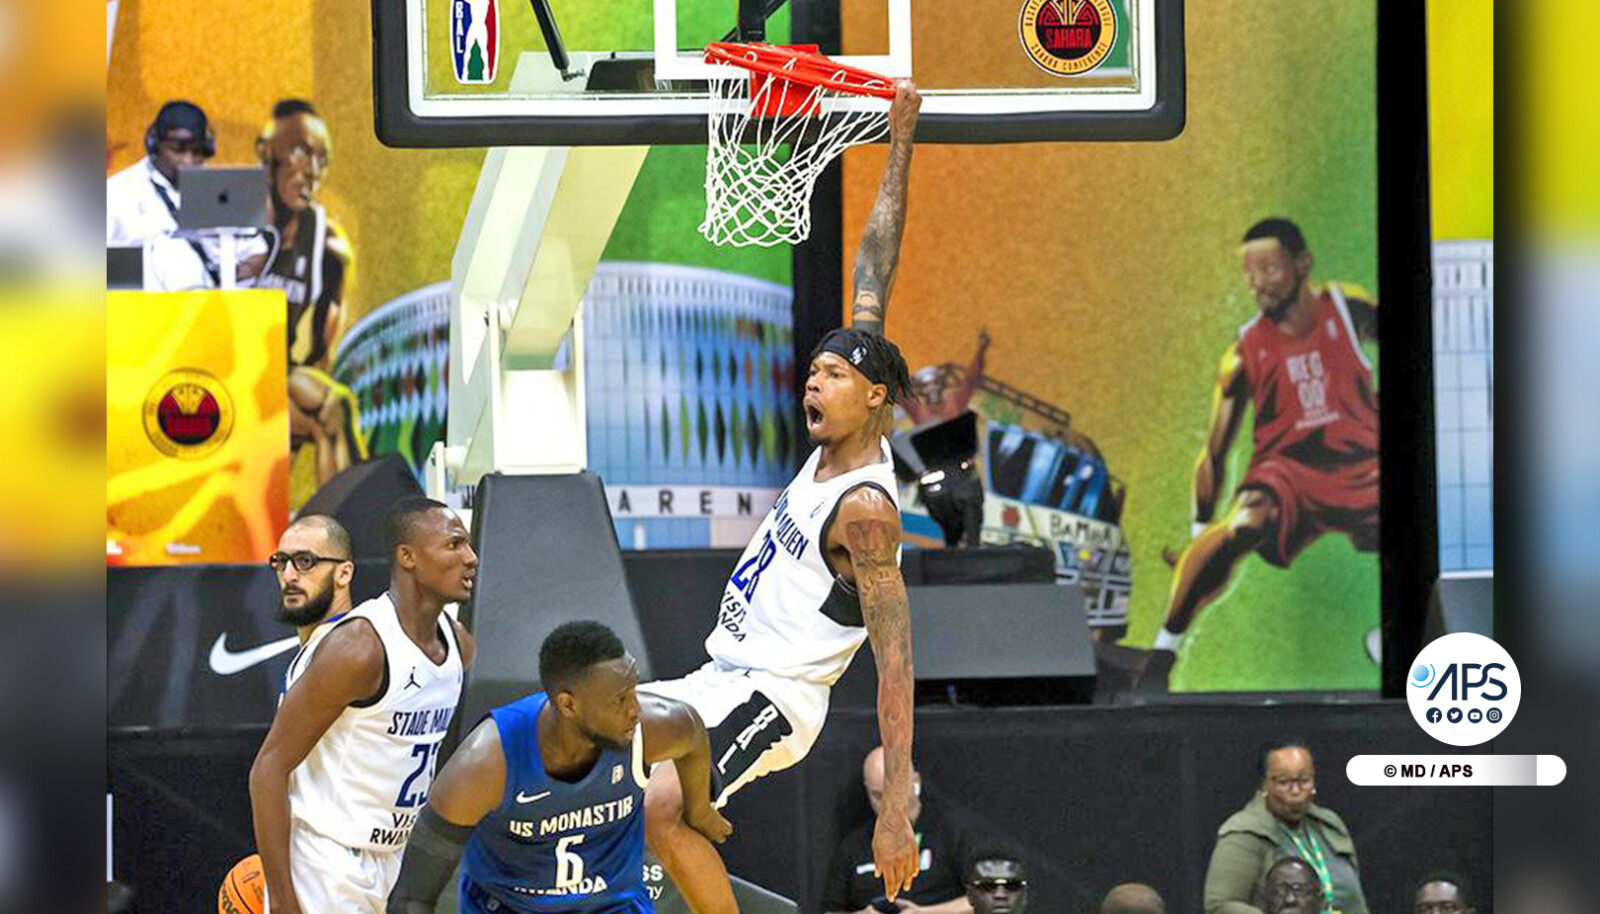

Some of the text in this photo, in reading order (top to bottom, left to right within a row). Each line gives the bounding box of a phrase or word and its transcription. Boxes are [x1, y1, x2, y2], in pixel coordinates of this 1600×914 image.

[455, 1, 464, 54] BAL
[1044, 27, 1093, 48] SAHARA
[618, 490, 753, 515] AREN
[387, 710, 431, 736] STADE
[717, 703, 779, 775] BAL
[392, 812, 417, 829] VIS
[509, 795, 634, 837] US MONASTIR
[554, 834, 585, 889] 6
